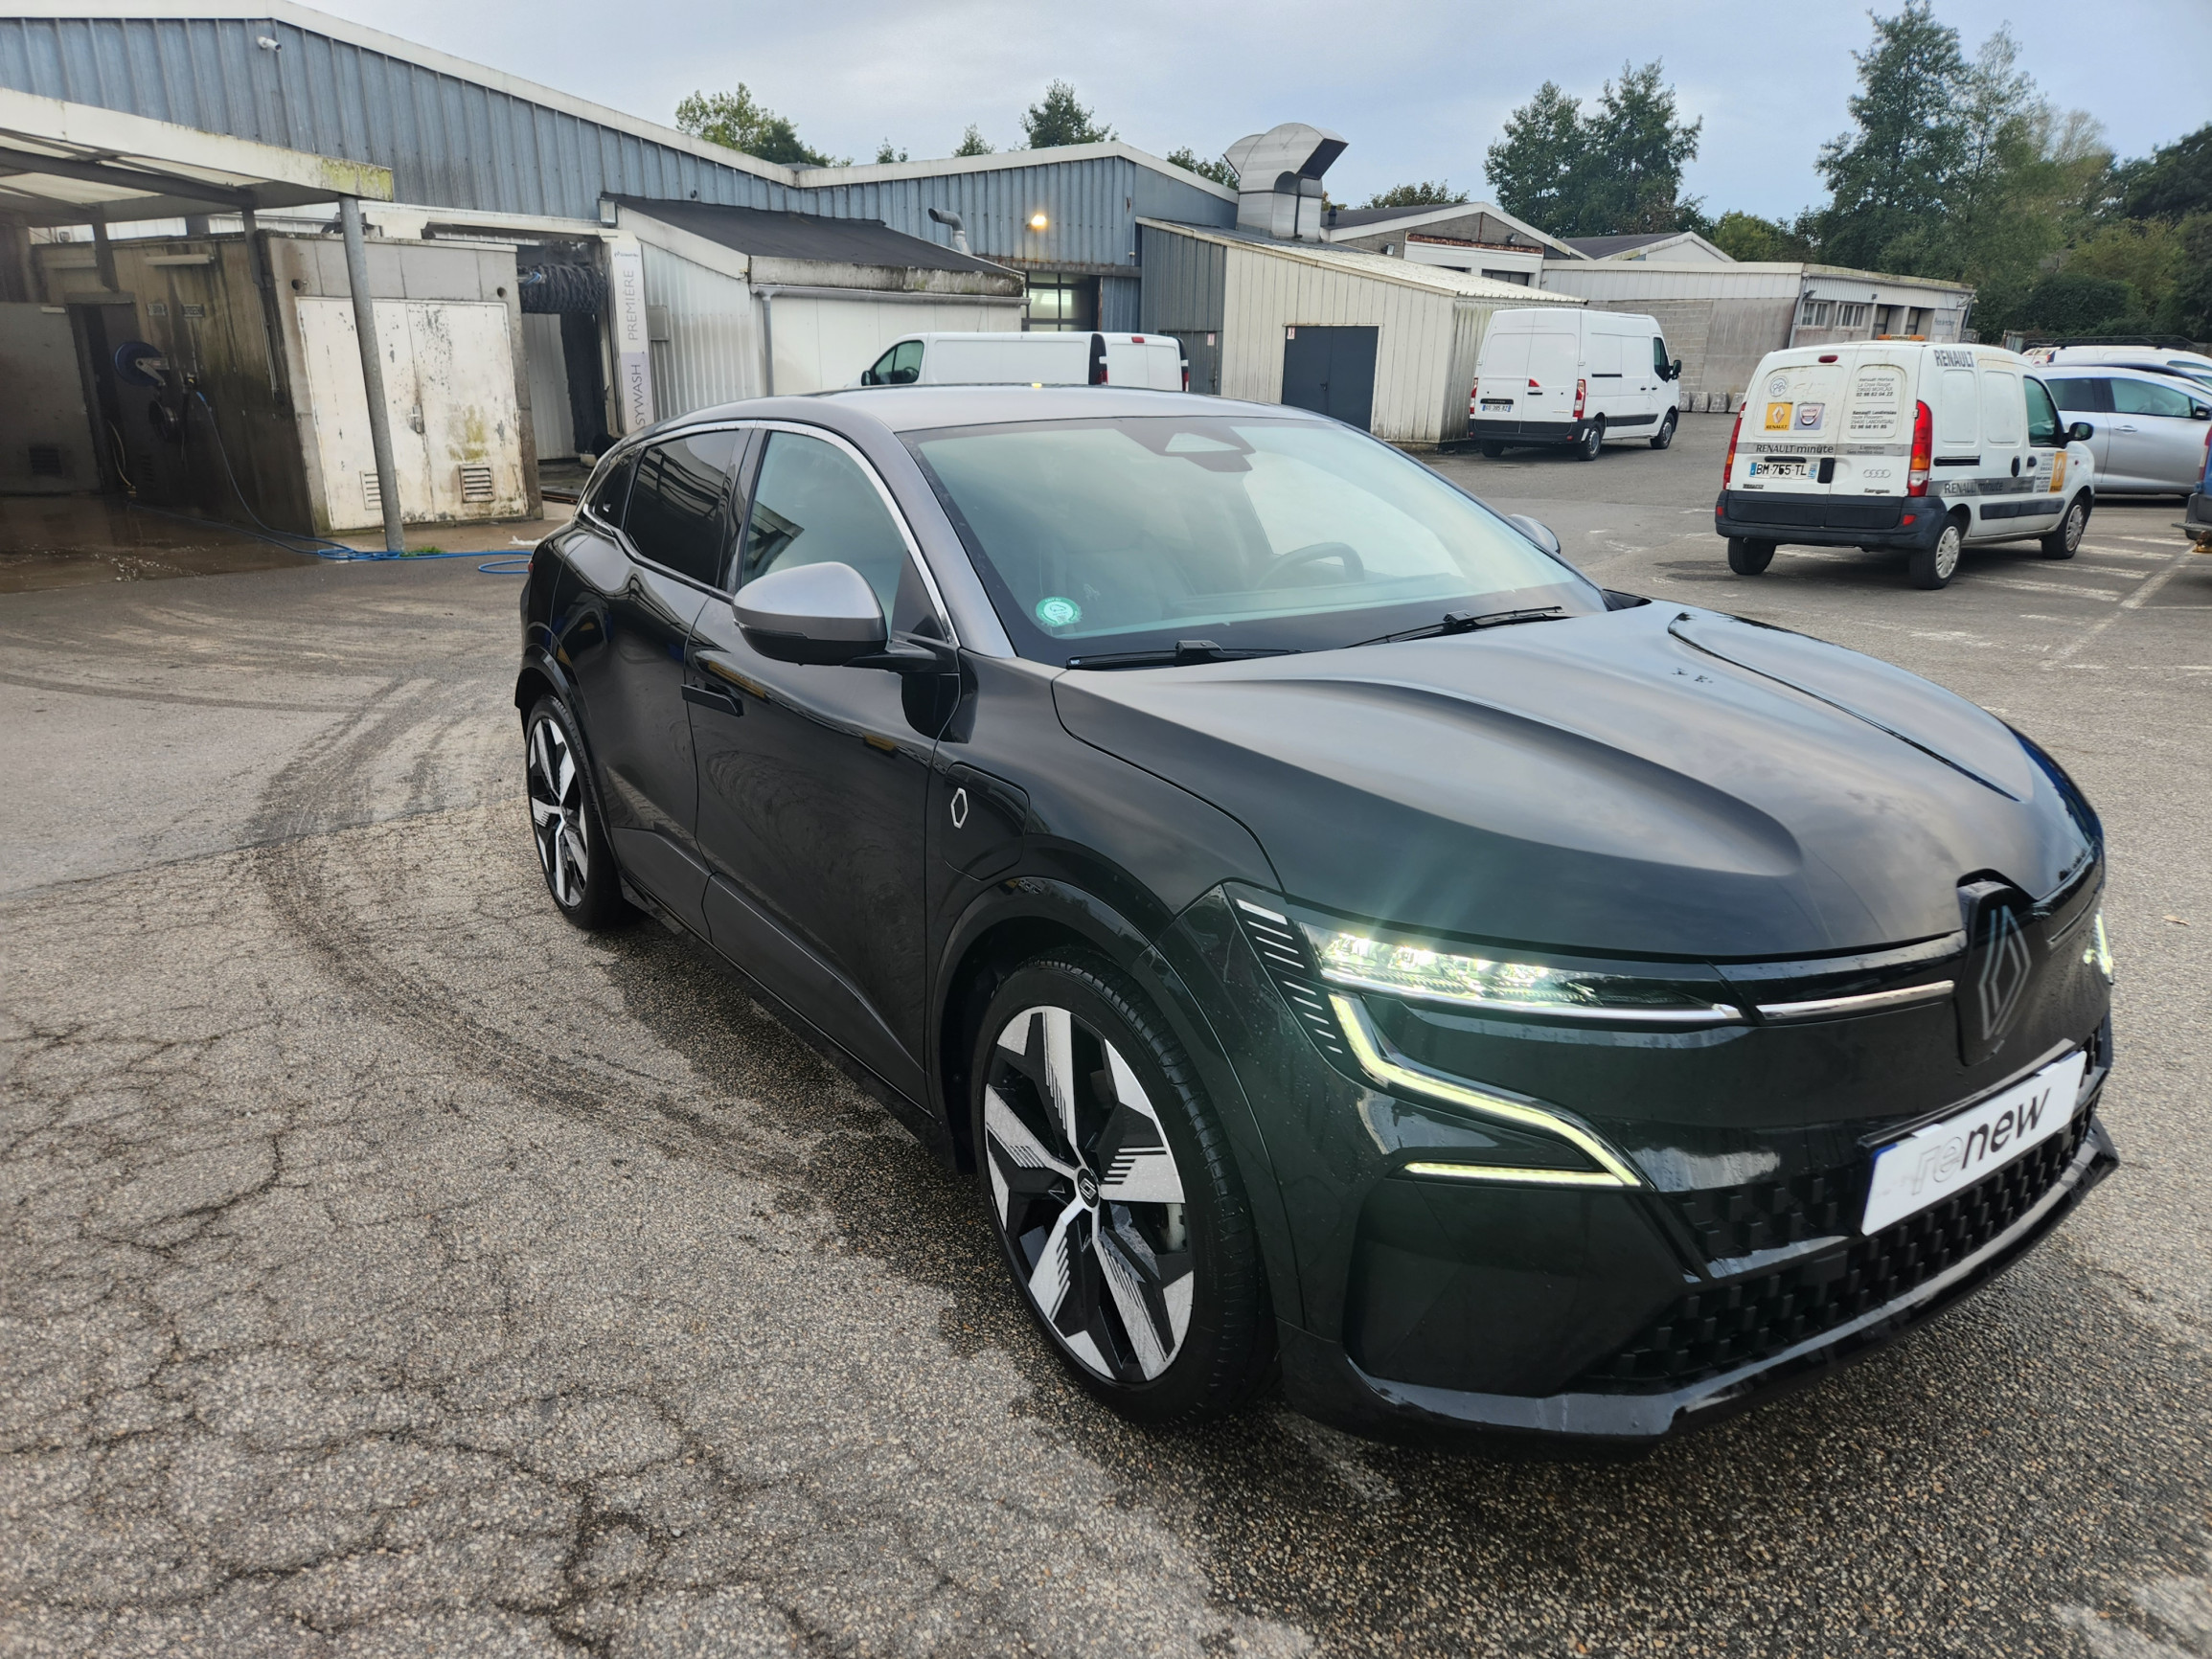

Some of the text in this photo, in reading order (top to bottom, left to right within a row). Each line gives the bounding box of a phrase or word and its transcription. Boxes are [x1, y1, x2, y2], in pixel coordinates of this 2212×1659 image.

[623, 269, 639, 341] PREMIÈRE
[1933, 349, 1974, 368] RENAULT
[1756, 443, 1795, 453] RENAULT
